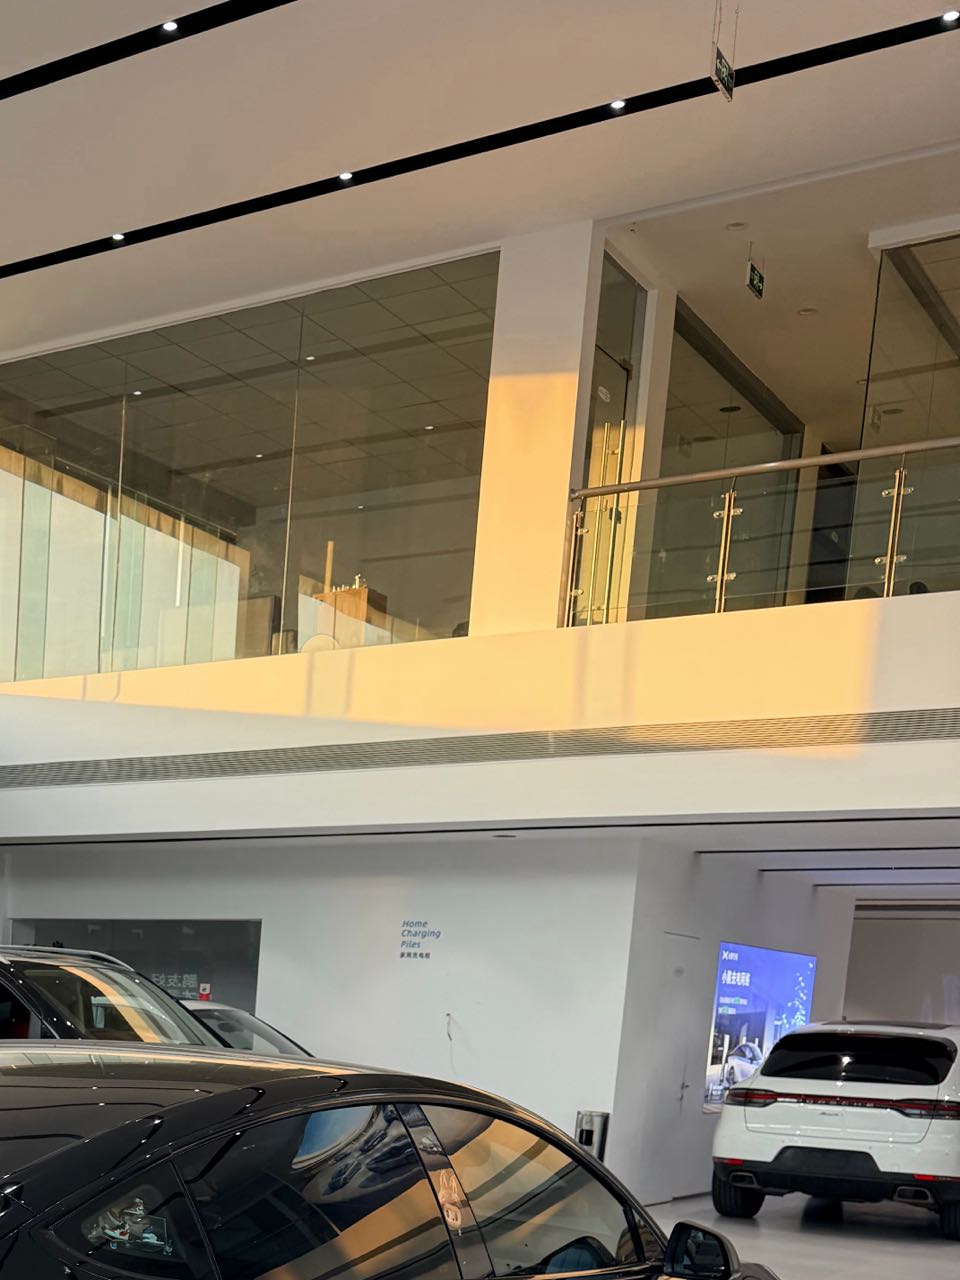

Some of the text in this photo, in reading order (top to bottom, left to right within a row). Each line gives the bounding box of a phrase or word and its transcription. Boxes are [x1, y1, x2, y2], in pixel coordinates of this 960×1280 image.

[401, 920, 428, 928] Home
[401, 929, 441, 939] Charging
[400, 940, 421, 948] Piles
